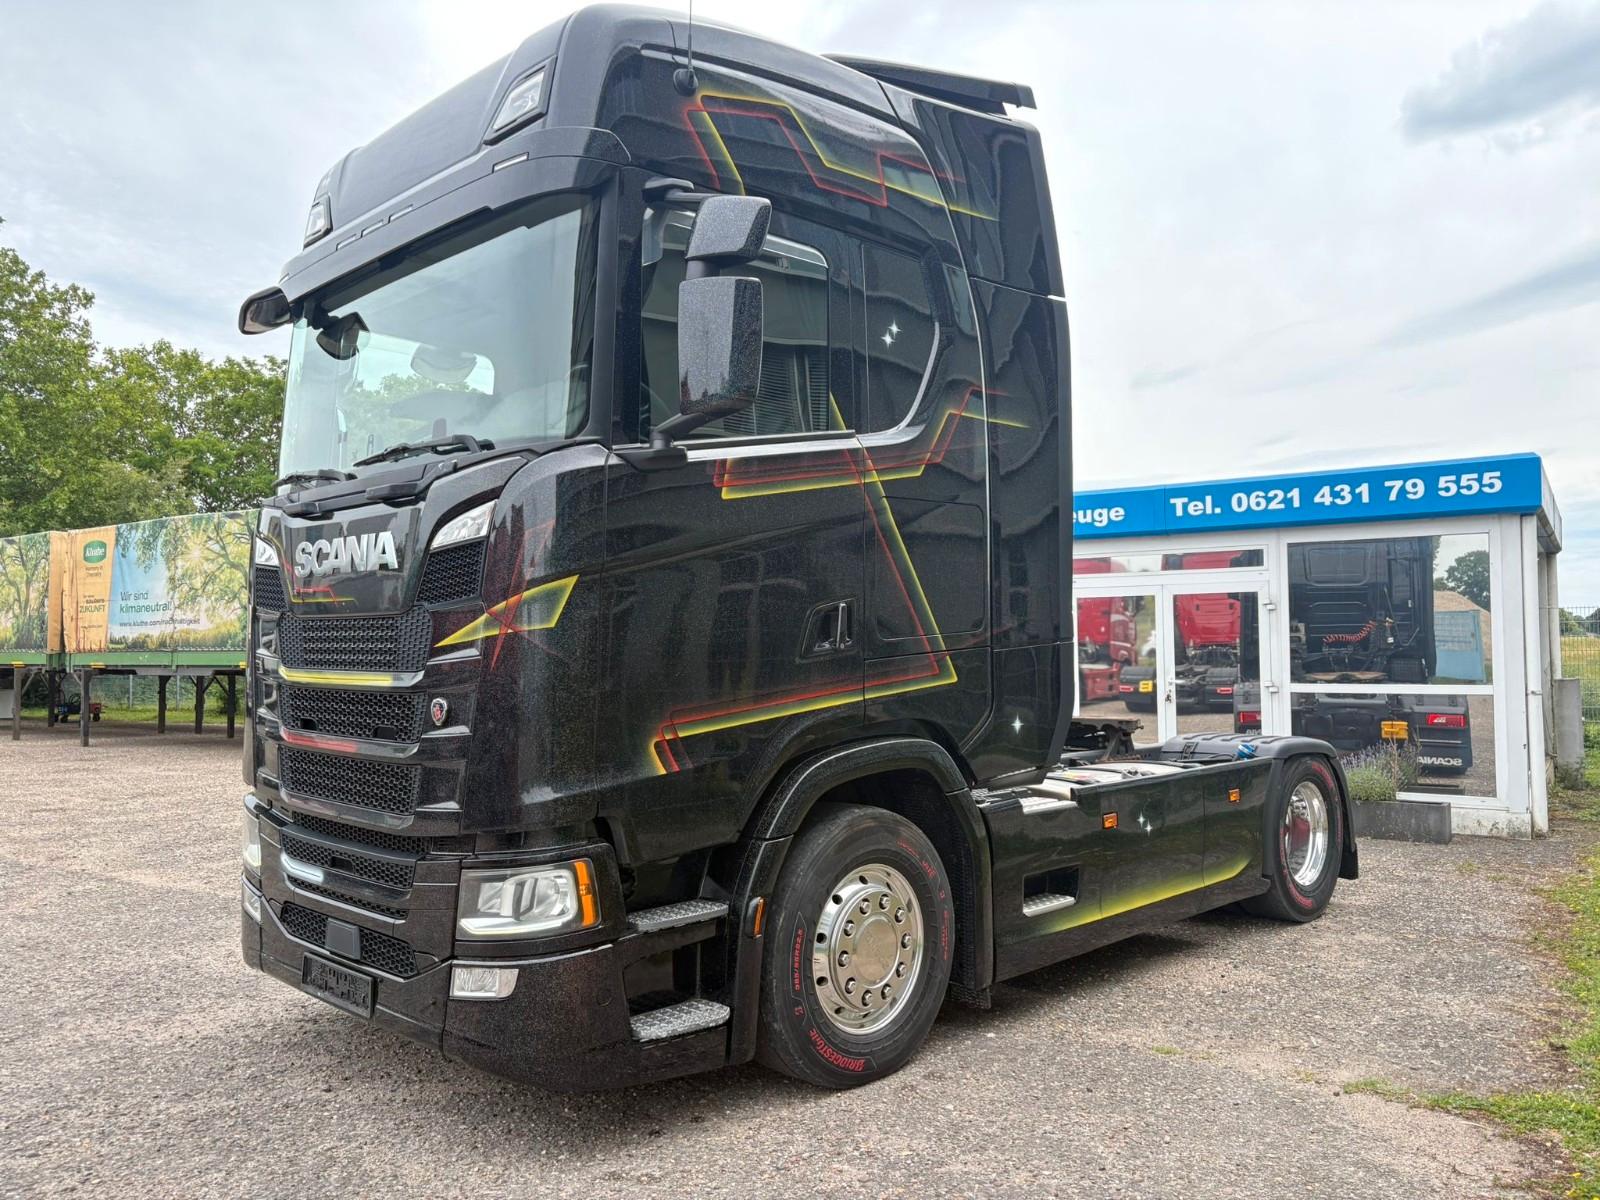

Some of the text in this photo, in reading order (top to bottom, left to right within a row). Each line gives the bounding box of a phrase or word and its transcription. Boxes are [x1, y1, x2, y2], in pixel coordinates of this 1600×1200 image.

[1073, 471, 1503, 527] uge Tel. 0621 431 79 555
[294, 531, 398, 578] SCANIA
[120, 592, 148, 601] Wir sind
[809, 1028, 866, 1072] BRIDGESTONE
